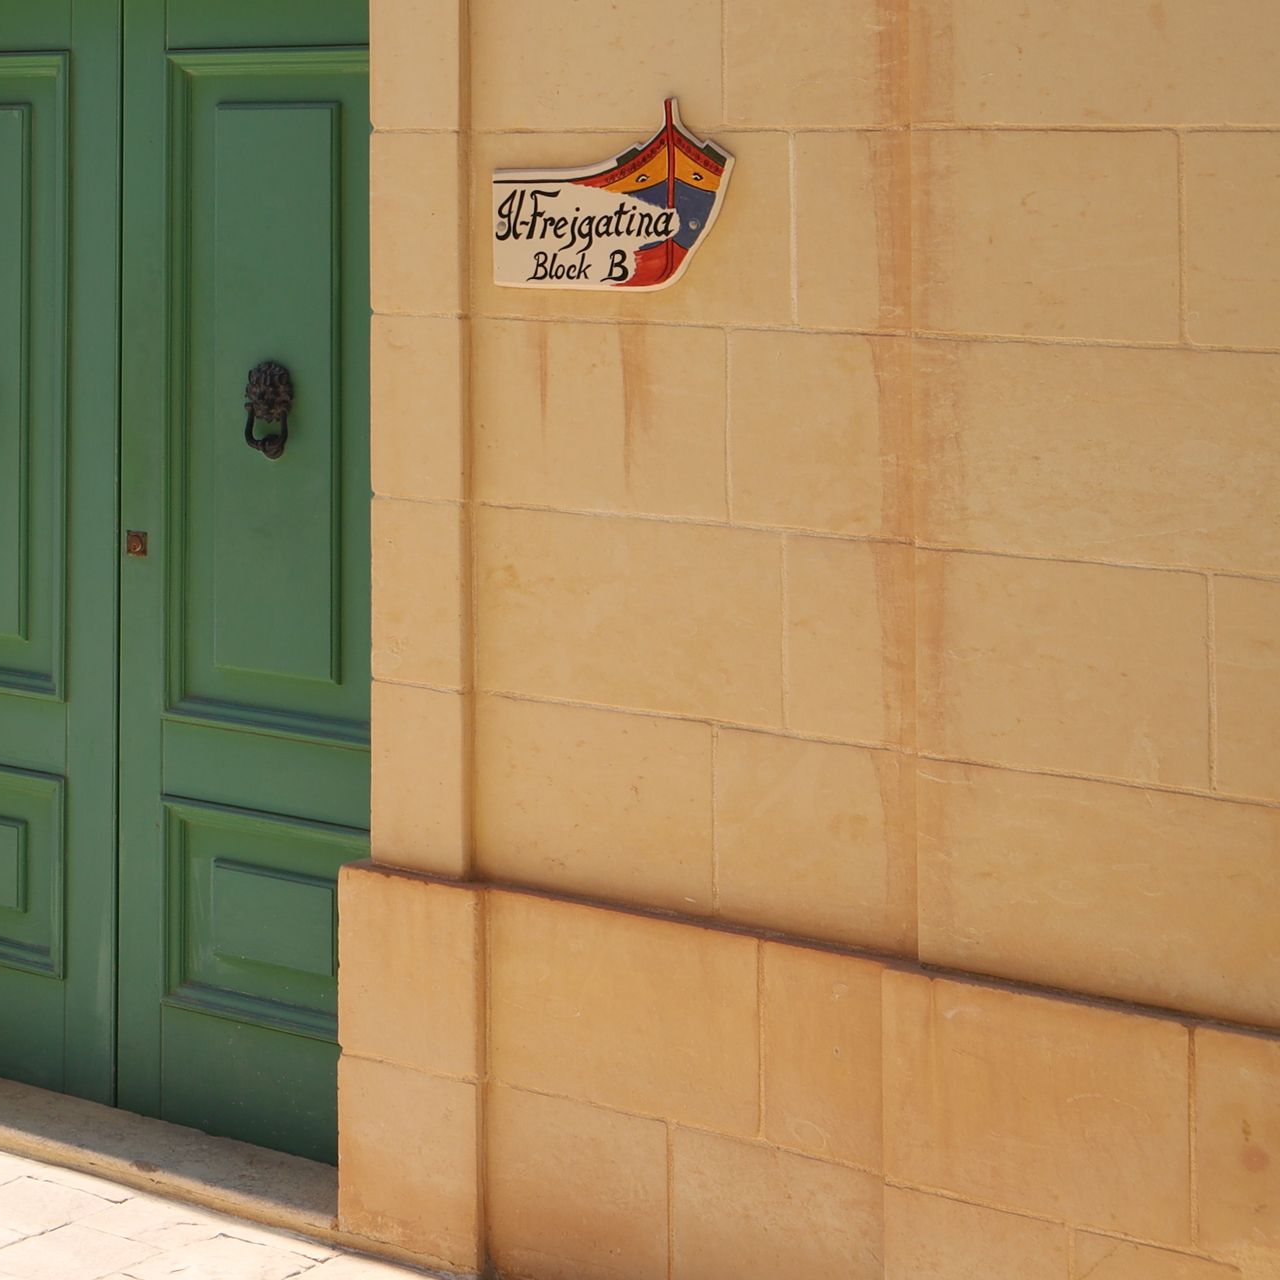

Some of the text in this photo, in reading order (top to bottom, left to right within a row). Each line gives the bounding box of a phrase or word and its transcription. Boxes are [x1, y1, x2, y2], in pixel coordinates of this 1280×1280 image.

[495, 189, 676, 255] Il-Frejgatina
[526, 249, 629, 282] Block B
